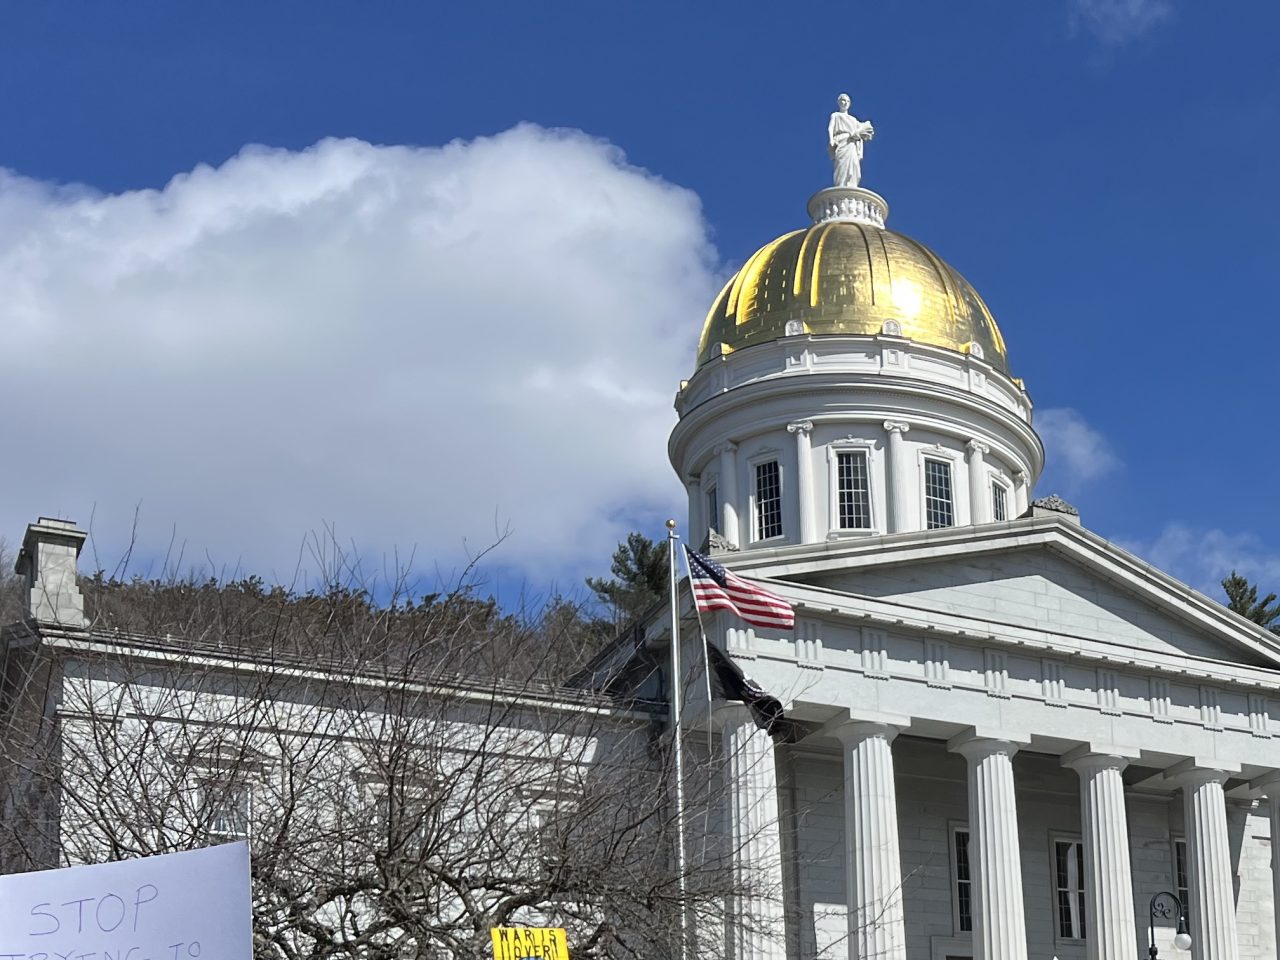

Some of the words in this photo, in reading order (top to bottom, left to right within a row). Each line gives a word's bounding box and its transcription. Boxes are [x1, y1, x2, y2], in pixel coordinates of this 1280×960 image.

[29, 884, 158, 936] STOP
[499, 929, 534, 941] WAR
[541, 929, 556, 941] IS
[514, 945, 551, 957] OVER
